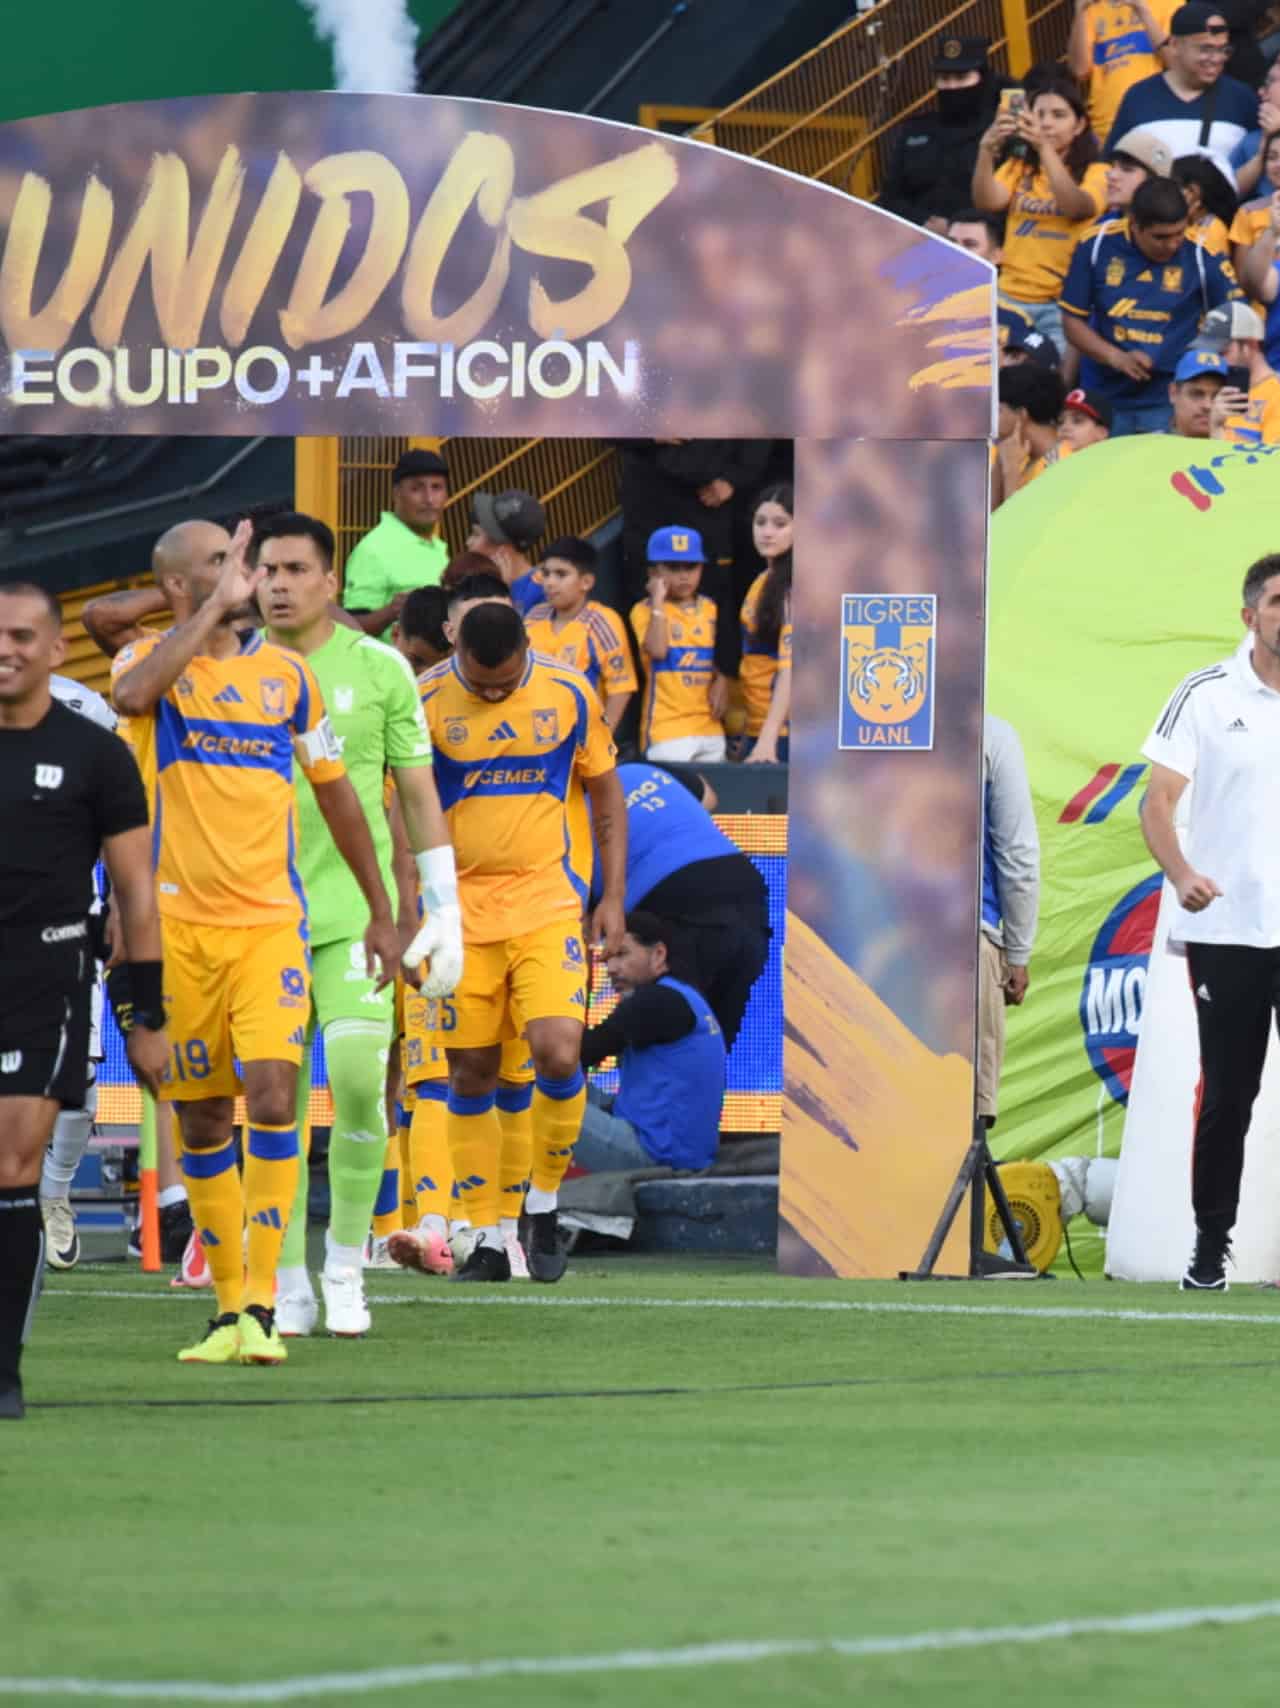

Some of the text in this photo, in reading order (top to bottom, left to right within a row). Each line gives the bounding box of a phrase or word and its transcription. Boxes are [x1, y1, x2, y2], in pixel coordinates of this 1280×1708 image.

[1, 131, 679, 351] UNIDOS
[845, 598, 933, 625] TIGRES
[202, 732, 275, 757] CEMEX
[858, 725, 913, 745] UANL
[479, 767, 548, 786] CEMEX
[172, 1038, 212, 1081] 19
